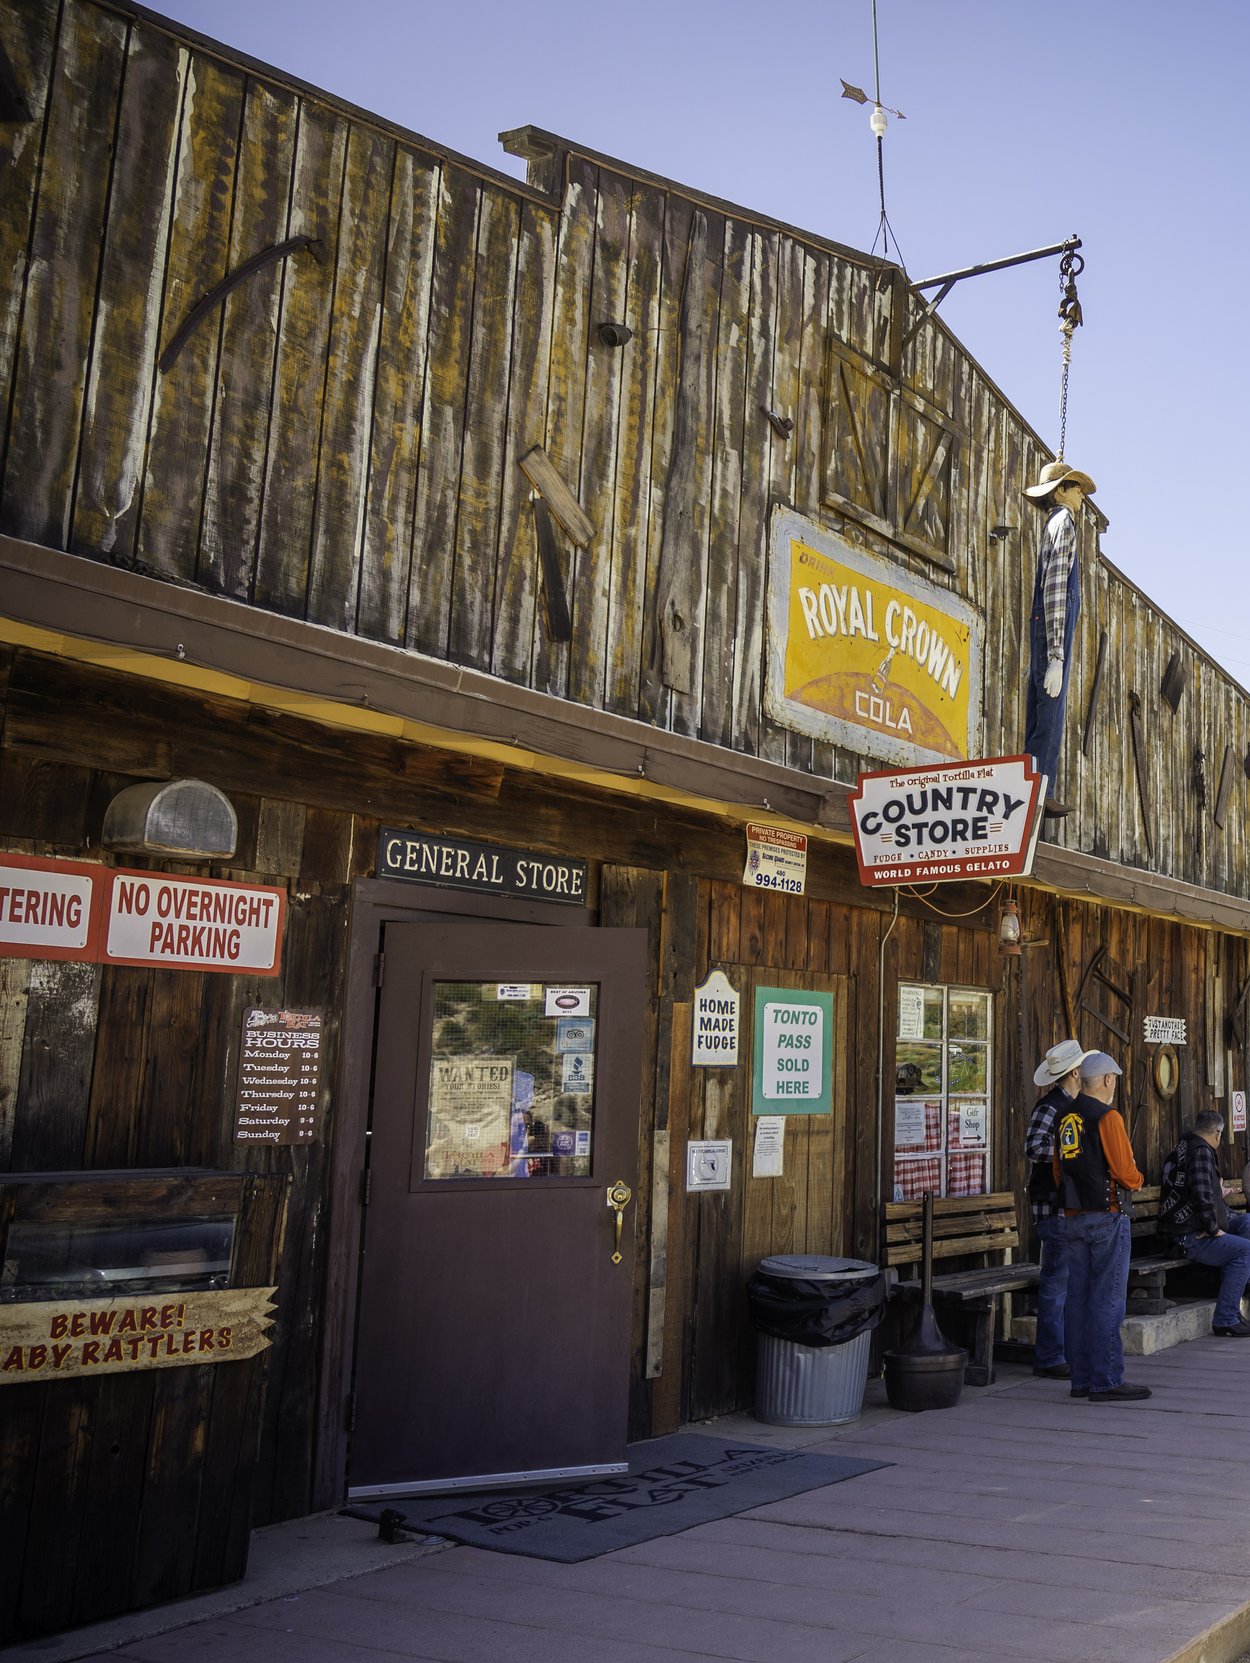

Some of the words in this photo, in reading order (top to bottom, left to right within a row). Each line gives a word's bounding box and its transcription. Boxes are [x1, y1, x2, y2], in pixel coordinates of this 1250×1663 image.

[799, 552, 835, 578] DRINK
[798, 584, 879, 641] ROYAL
[885, 600, 964, 699] CROWN
[856, 689, 913, 734] COLA
[890, 779, 905, 788] The
[907, 773, 940, 788] Original
[943, 770, 975, 782] Tortilla
[977, 768, 994, 779] Flat
[860, 786, 1025, 835] COUNTRY
[751, 826, 776, 838] PRIVATE
[776, 831, 804, 843] PROPERTY
[895, 816, 988, 847] STORE
[768, 836, 797, 848] TRESPASSING
[873, 853, 902, 863] FUDGE
[918, 850, 949, 860] CANDY
[964, 844, 1009, 855] SUPPLIES
[386, 839, 503, 883] GENERAL
[516, 860, 583, 895] STORE
[874, 869, 911, 879] WORLD
[916, 864, 961, 876] FAMOUS
[966, 860, 1010, 871] GELATO
[117, 882, 150, 916] NO
[157, 886, 273, 928] OVERNIGHT
[149, 922, 240, 960] PARKING
[699, 998, 736, 1015] HOME
[700, 1016, 735, 1032] MADE
[773, 1009, 818, 1025] TONTO
[246, 1030, 320, 1039] BUSINESS
[697, 1034, 736, 1050] FUDGE
[777, 1034, 812, 1049] PASS
[1150, 1029, 1169, 1039] PRETTY
[1172, 1031, 1183, 1040] FACE
[245, 1038, 319, 1048] HOURS
[244, 1050, 290, 1059] Monday
[243, 1064, 290, 1072] Tuesday
[777, 1058, 810, 1072] SOLD
[242, 1077, 298, 1086] Wednesday
[438, 1066, 509, 1082] WANTED
[241, 1090, 295, 1099] Thursday
[776, 1081, 809, 1094] HERE
[240, 1104, 279, 1112] Friday
[966, 1107, 979, 1117] Gift
[238, 1117, 290, 1126] Saturday
[964, 1119, 980, 1131] Shop
[237, 1131, 280, 1140] Sunday
[50, 1303, 188, 1340] BEWARE!
[1, 1342, 73, 1372] ABY
[81, 1326, 233, 1367] RATTLERS
